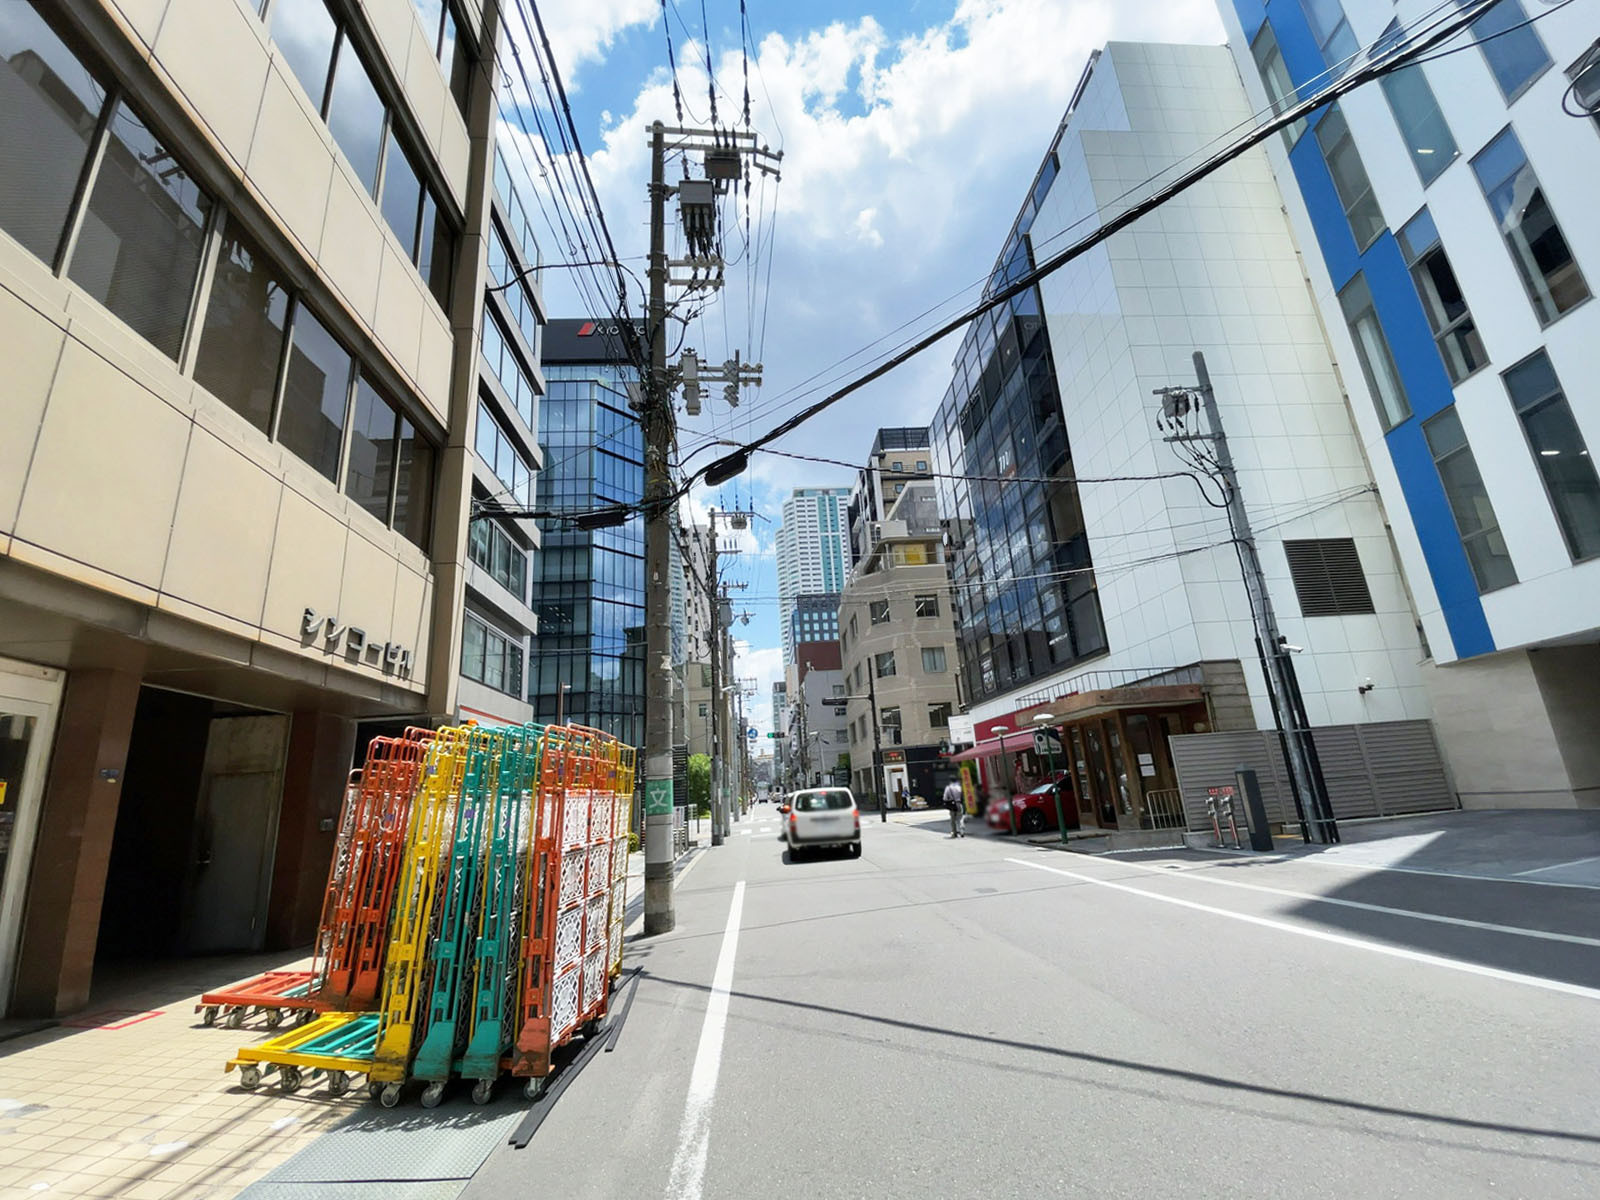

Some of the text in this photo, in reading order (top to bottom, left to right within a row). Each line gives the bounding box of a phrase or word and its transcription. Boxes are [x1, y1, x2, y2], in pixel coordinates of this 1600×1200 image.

[303, 607, 414, 671] シンコービル
